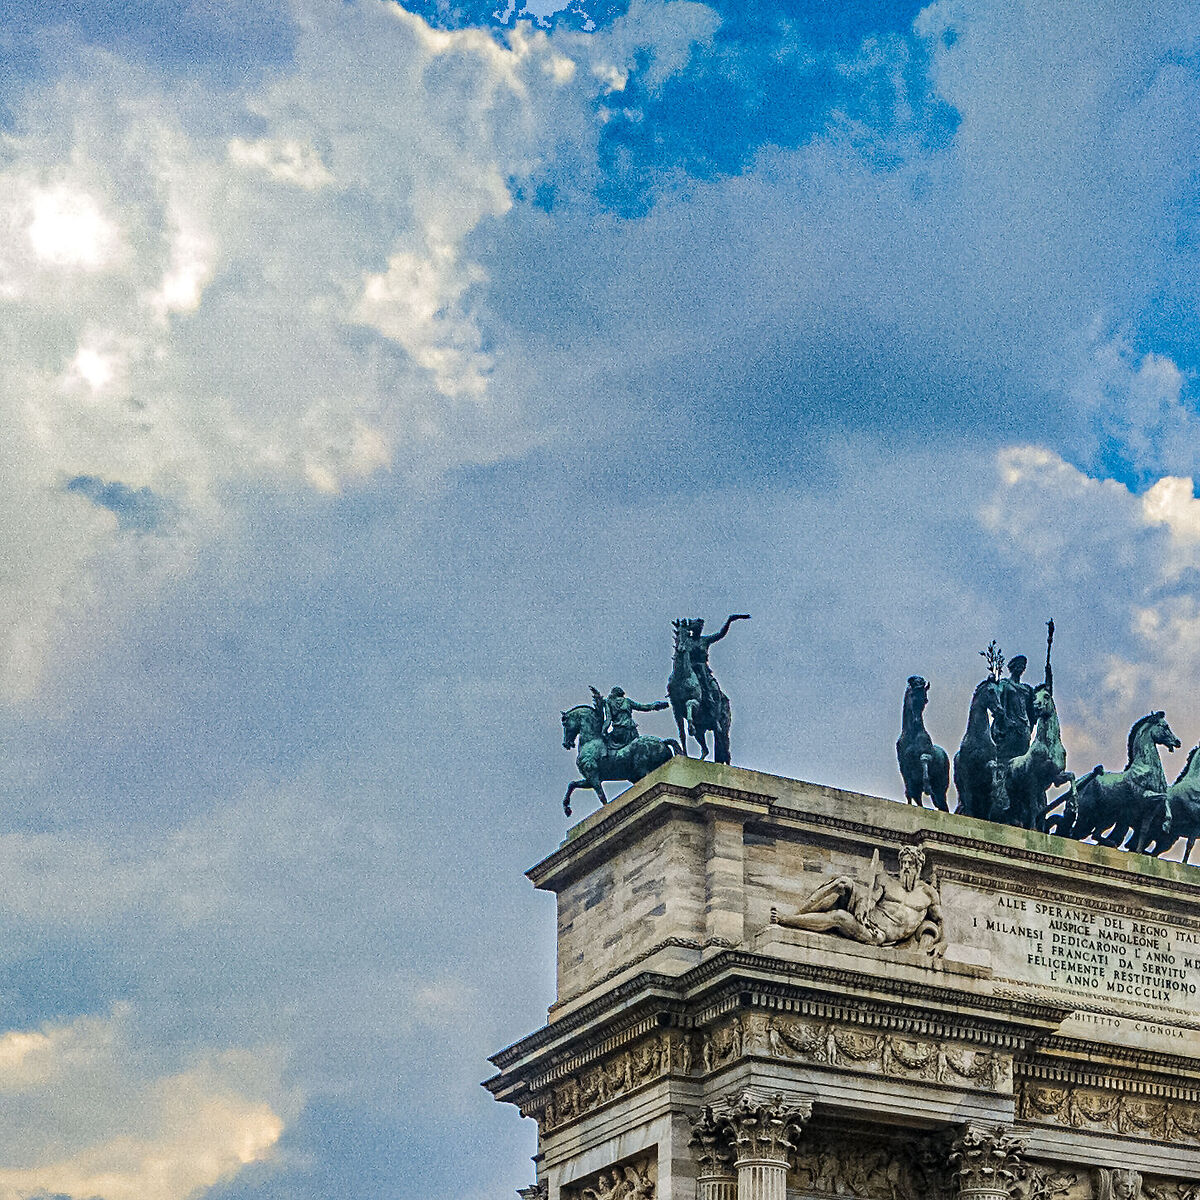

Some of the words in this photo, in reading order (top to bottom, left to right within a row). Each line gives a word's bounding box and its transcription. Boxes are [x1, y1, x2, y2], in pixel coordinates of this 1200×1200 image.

[997, 896, 1027, 911] ALLE
[1034, 903, 1096, 925] SPERANZE
[1104, 917, 1125, 930] DEL
[1132, 922, 1168, 939] REGNO
[986, 919, 1044, 940] MILANESI
[1052, 933, 1127, 956] DEDICARONO
[1048, 919, 1091, 936] AUSPICE
[1098, 929, 1160, 950] NAPOLEONE
[1051, 945, 1109, 966] FRANCATI
[1118, 958, 1133, 970] DA
[1027, 953, 1106, 978] FELICEMENTE
[1113, 969, 1197, 994] RESTITUIRONO
[1106, 980, 1171, 1002] MDCCCLIX
[1134, 1023, 1185, 1039] CAGNOLA
